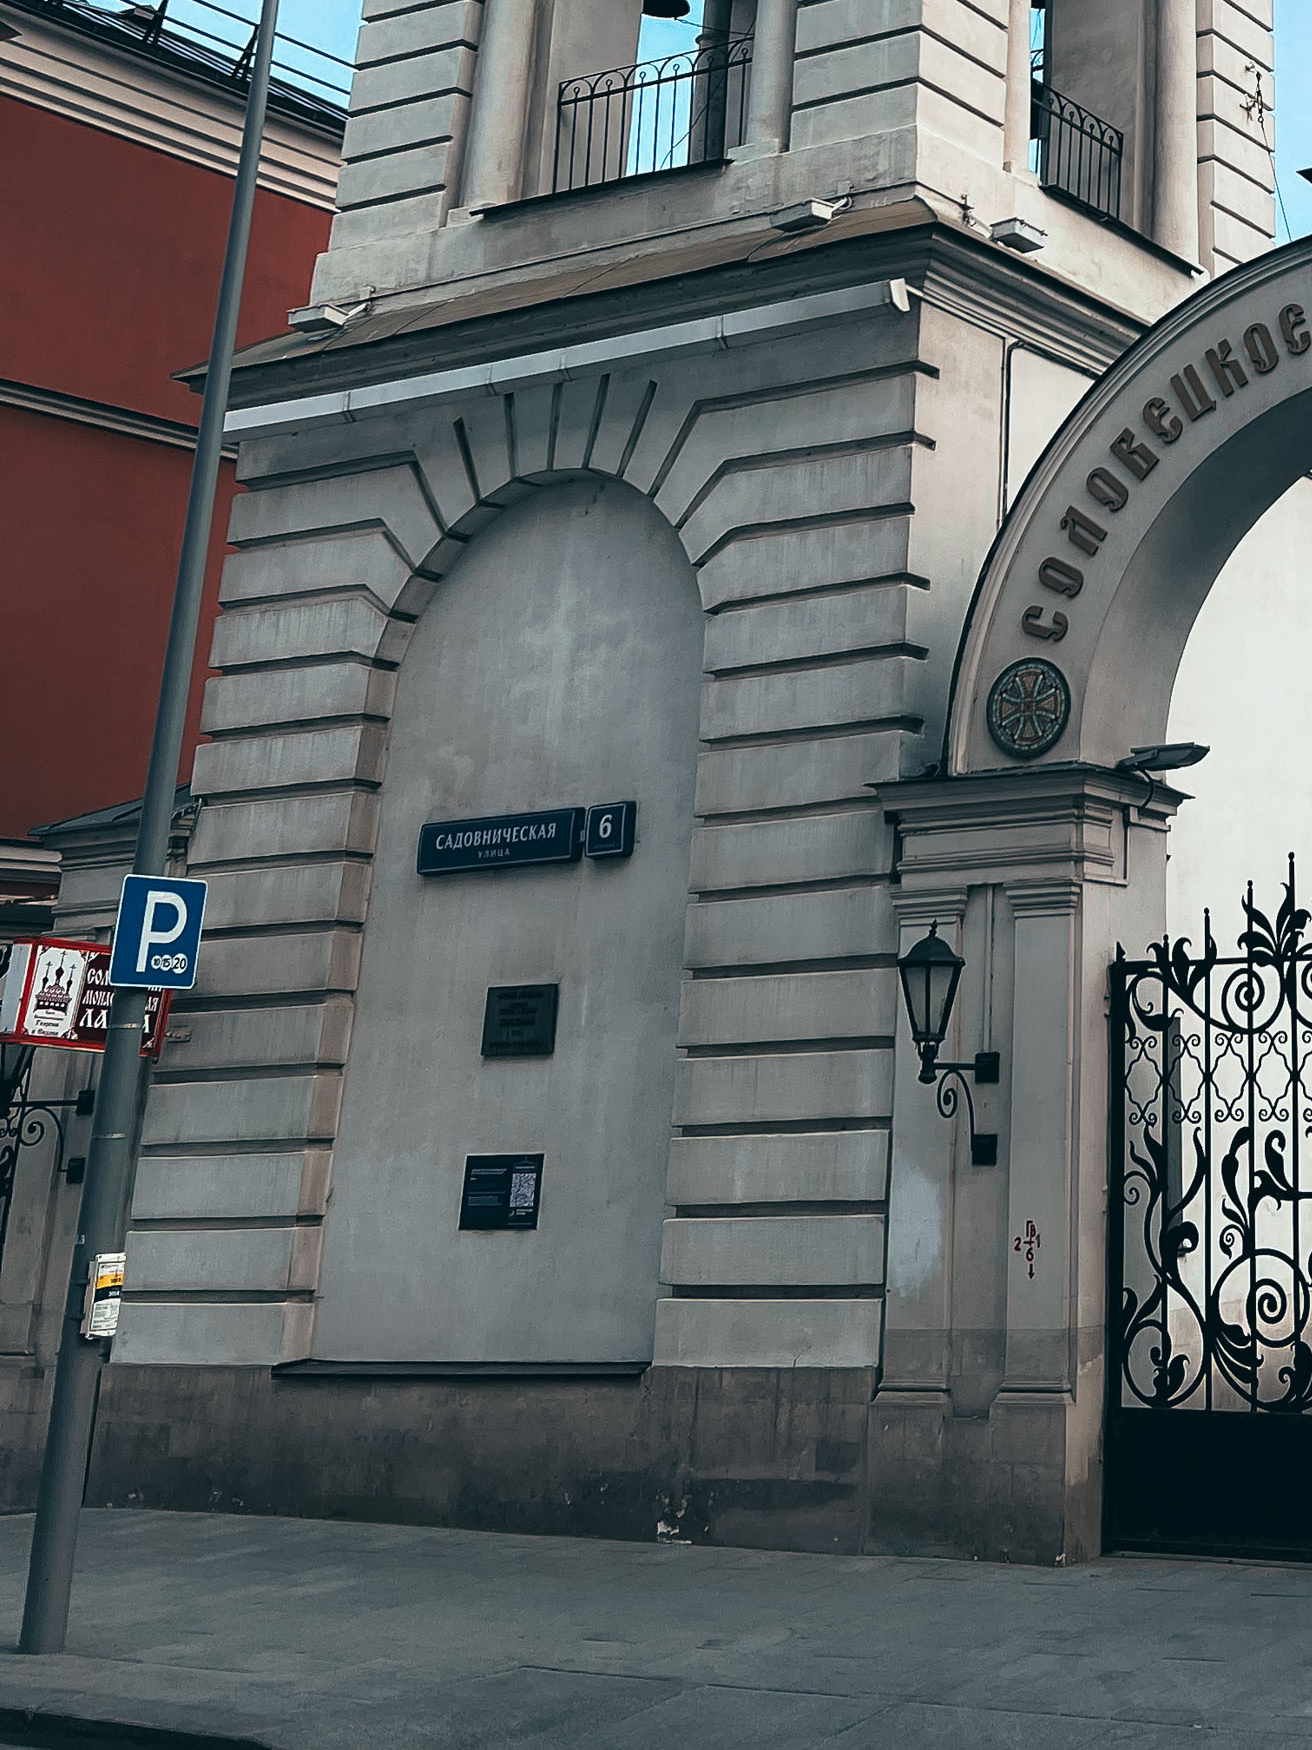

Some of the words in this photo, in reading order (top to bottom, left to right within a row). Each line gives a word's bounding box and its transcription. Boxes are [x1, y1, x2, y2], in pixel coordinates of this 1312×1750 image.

[1021, 303, 1312, 643] СОЛОВЕЦКОЕ
[436, 822, 557, 851] САДОВНИЧЕСКАЯ
[599, 814, 613, 839] 6
[477, 848, 511, 859] УЛИЦА
[135, 890, 188, 973] P
[173, 956, 187, 970] 20
